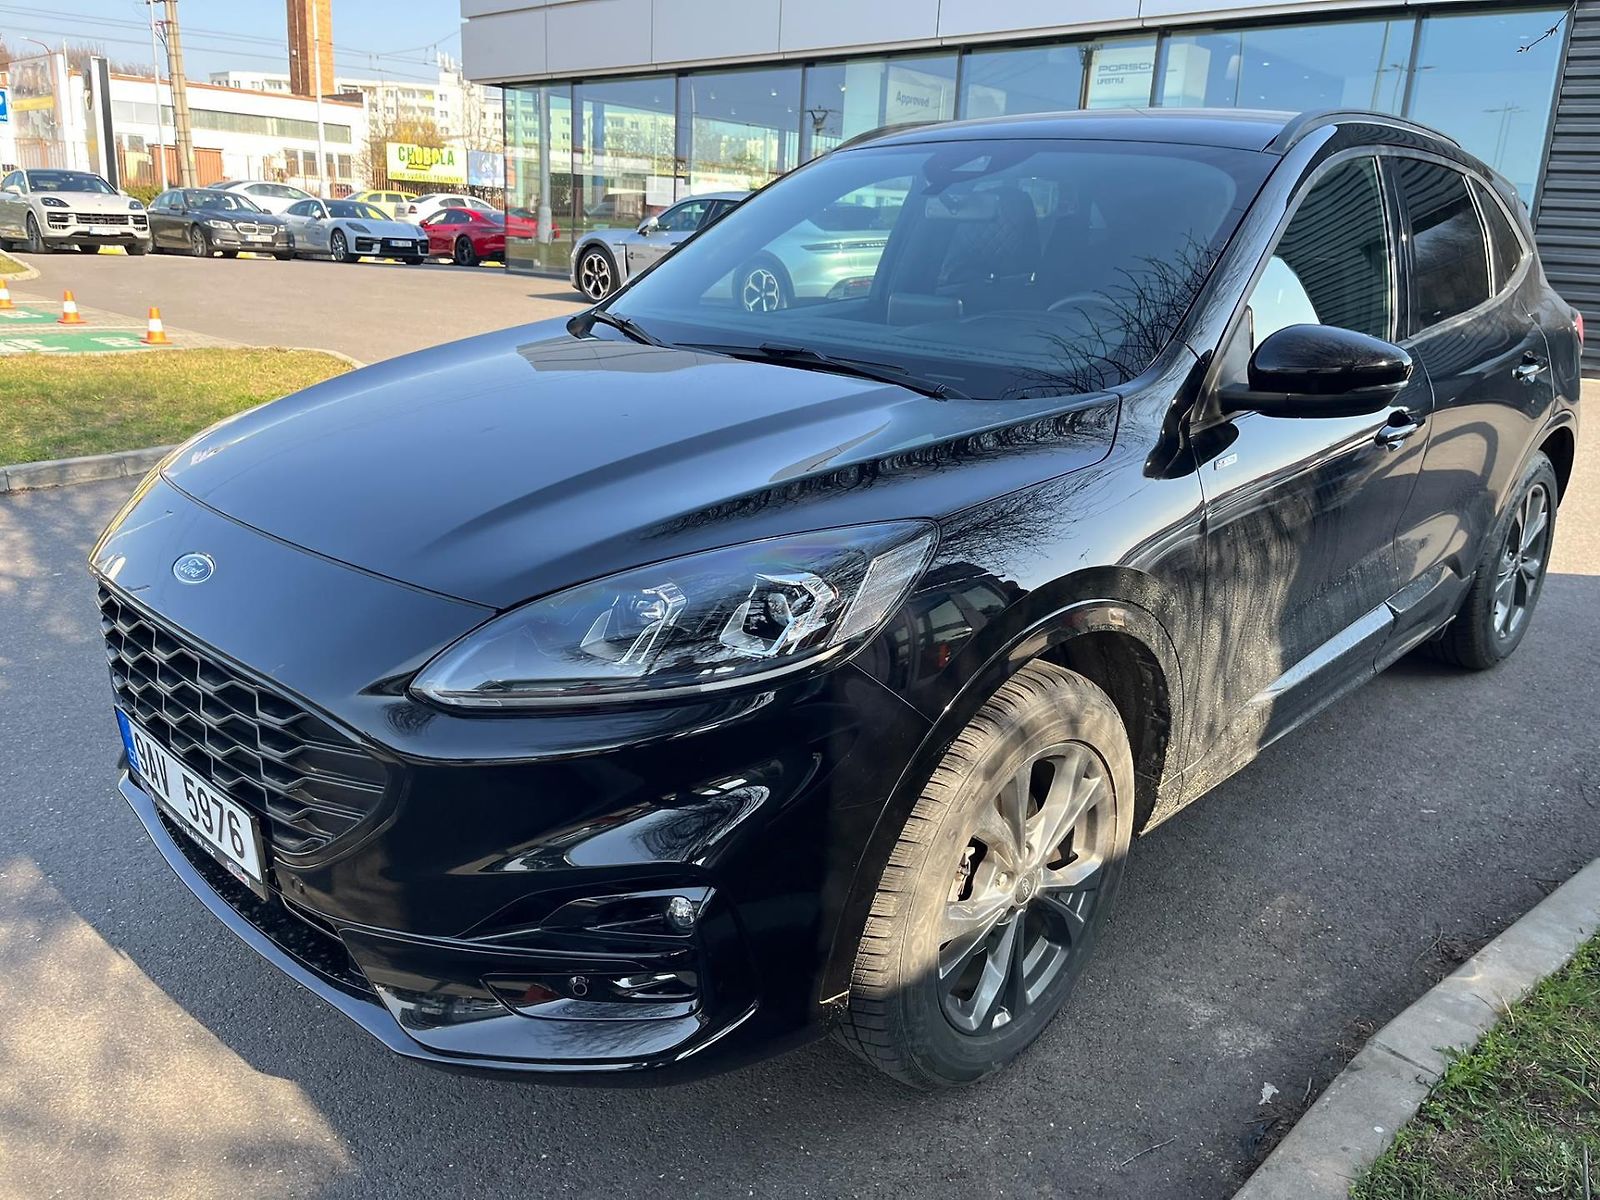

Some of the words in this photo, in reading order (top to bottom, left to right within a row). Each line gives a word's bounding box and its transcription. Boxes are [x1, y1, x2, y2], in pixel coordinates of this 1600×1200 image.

[1098, 62, 1155, 72] PORSC
[895, 90, 930, 107] Approved
[398, 145, 455, 166] CHOBOLA
[134, 732, 170, 798] 9AV
[182, 772, 245, 859] 5976
